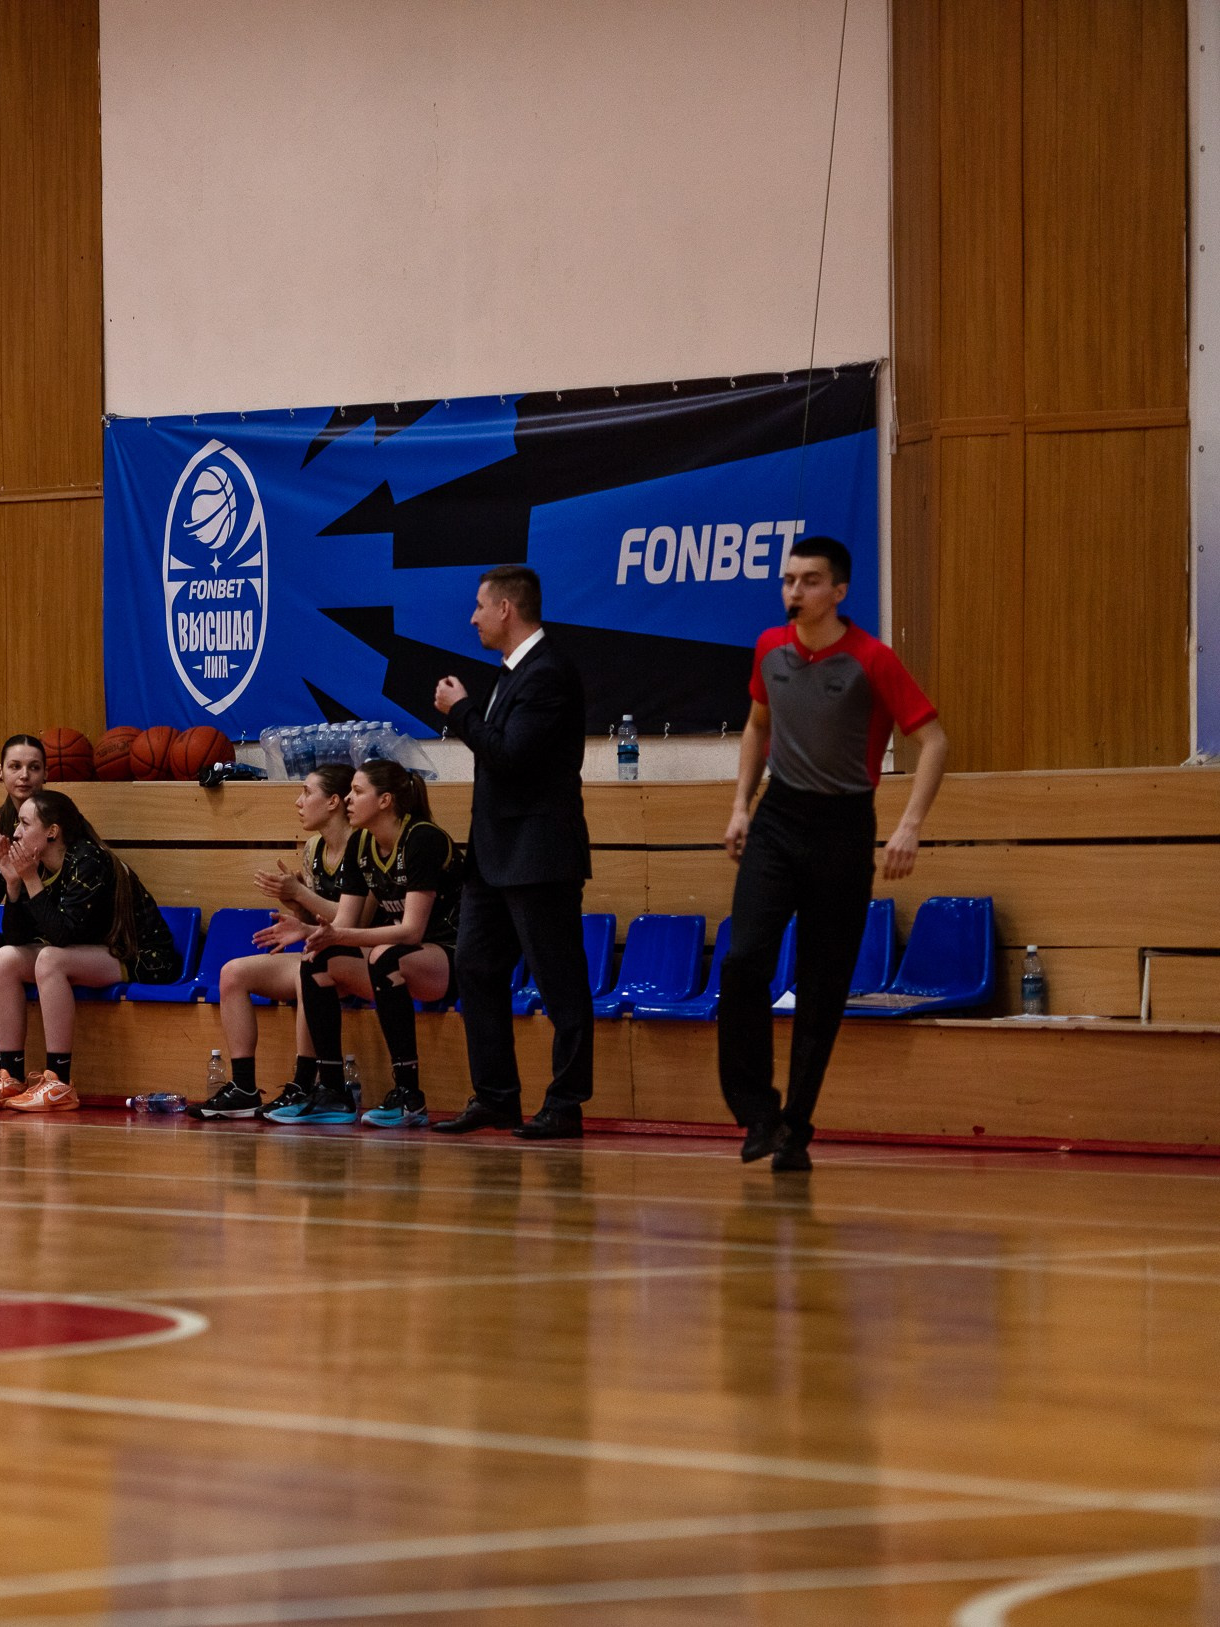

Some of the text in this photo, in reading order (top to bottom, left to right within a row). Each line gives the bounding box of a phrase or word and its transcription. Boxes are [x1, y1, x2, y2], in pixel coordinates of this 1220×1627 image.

[616, 520, 805, 585] FONBET
[189, 579, 245, 599] FONBET
[178, 610, 253, 652] ВЫСШАЯ
[204, 655, 229, 678] ЛИГА
